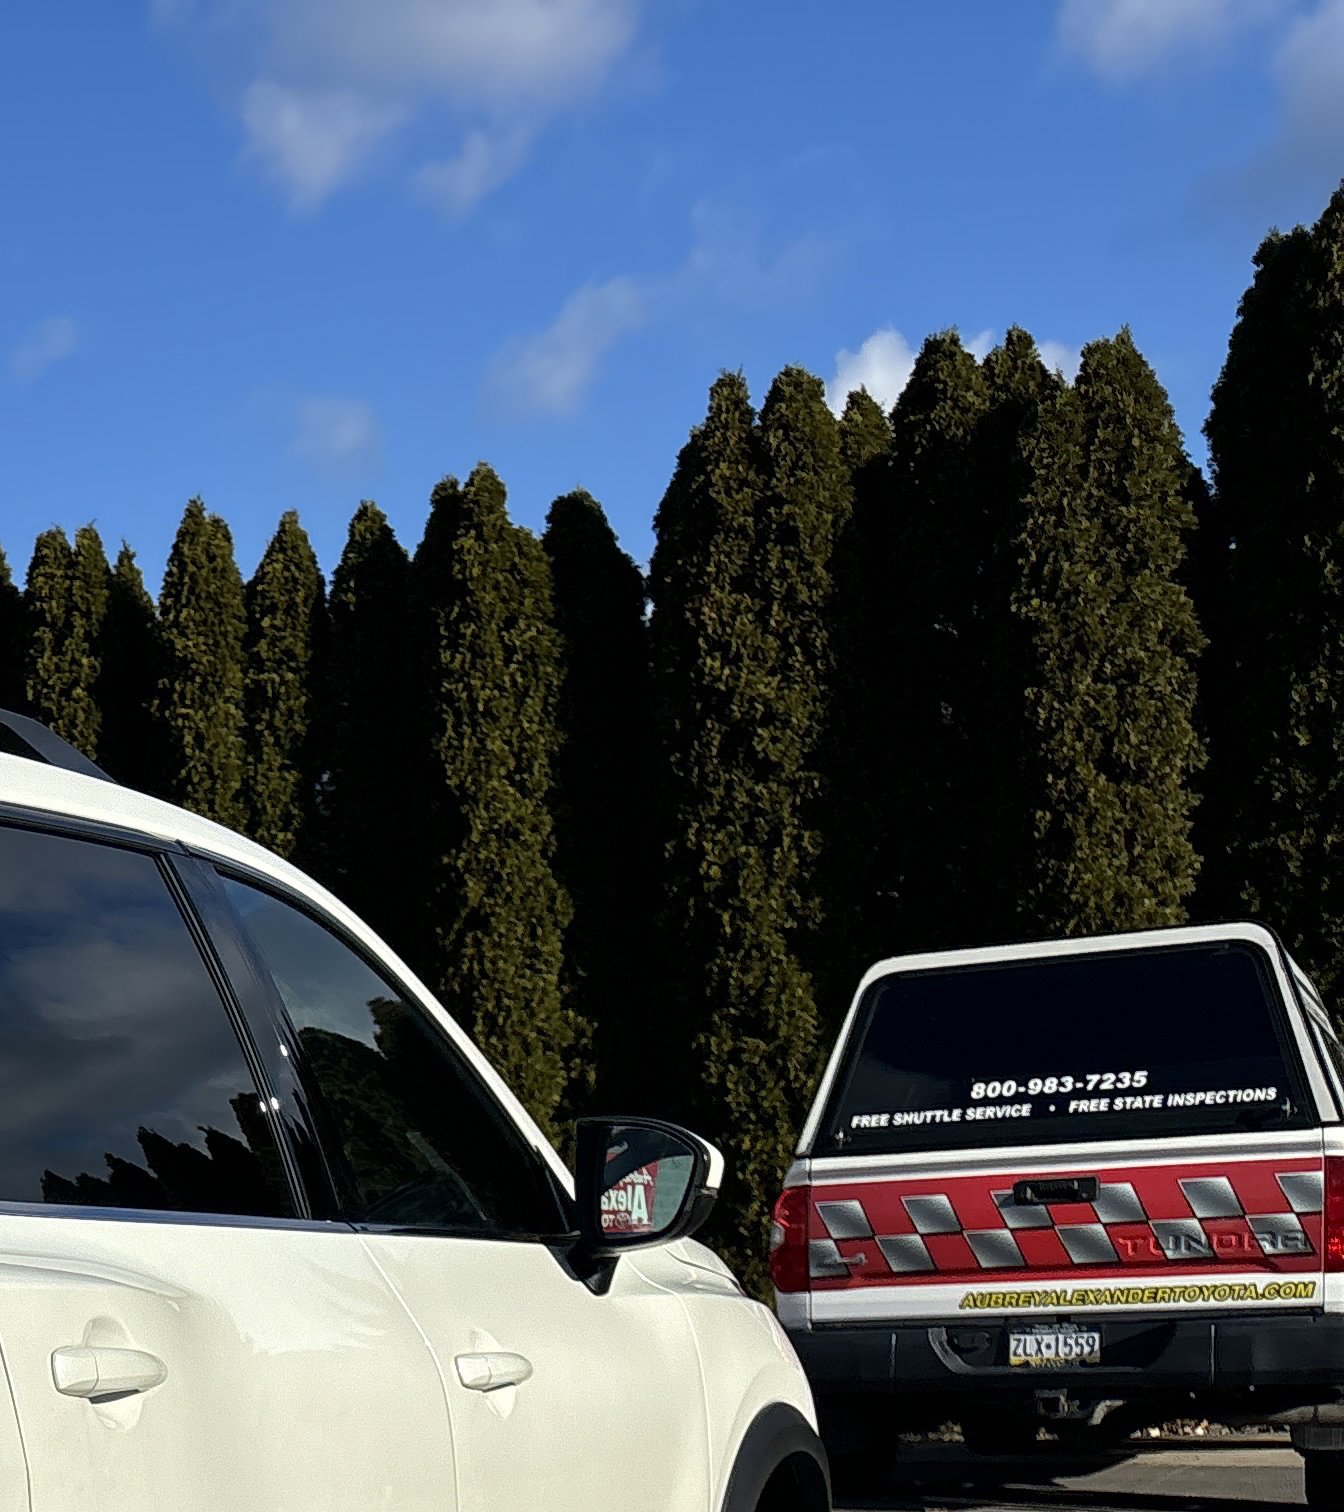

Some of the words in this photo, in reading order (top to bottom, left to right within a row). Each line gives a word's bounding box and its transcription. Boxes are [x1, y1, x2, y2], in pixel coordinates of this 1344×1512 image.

[970, 1070, 1148, 1099] 800-983-7235
[851, 1113, 890, 1129] FREE
[892, 1108, 962, 1126] SHUTTLE
[965, 1103, 1032, 1121] SERVICE
[1068, 1098, 1110, 1114] FREE
[1113, 1095, 1164, 1111] STATE
[1167, 1086, 1277, 1107] INSPECTIONS
[1117, 1229, 1311, 1257] TUNDRA
[959, 1281, 1316, 1310] AUBREYALEXANDERTOYOTA.COM
